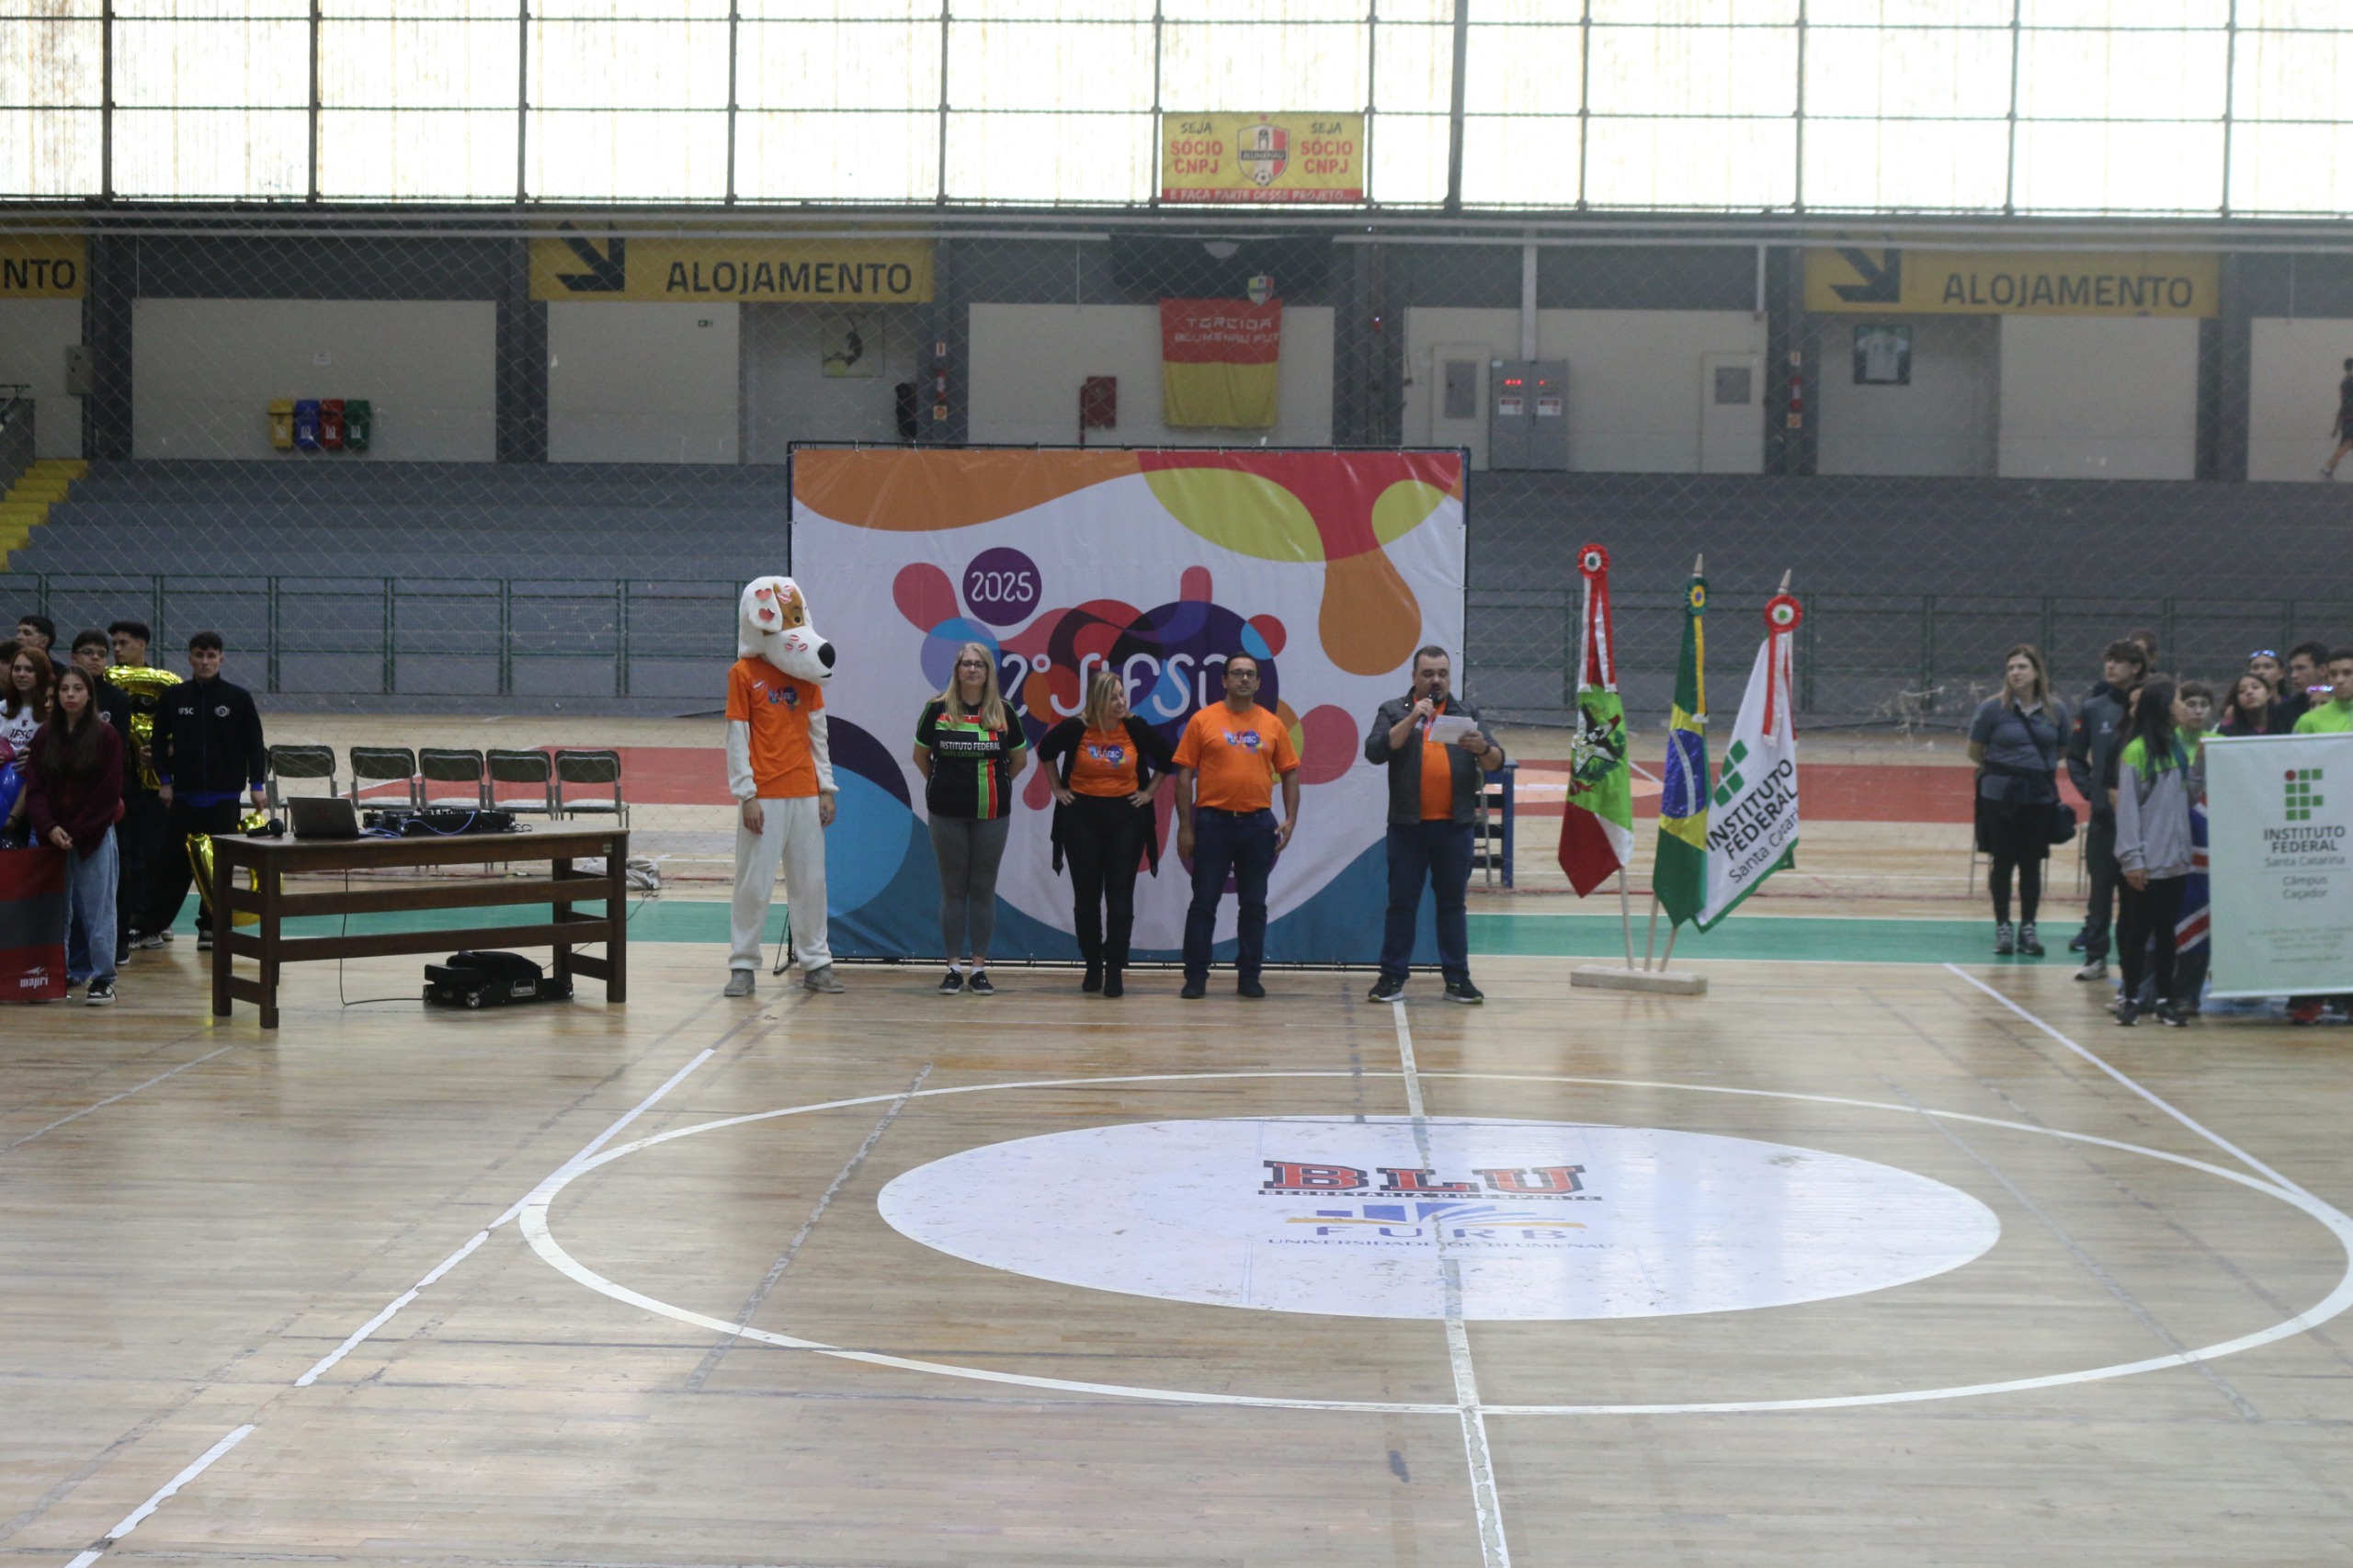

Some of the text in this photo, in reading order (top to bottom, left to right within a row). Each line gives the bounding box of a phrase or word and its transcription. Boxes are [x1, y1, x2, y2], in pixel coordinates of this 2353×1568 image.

[1180, 121, 1212, 134] SEJA
[1311, 121, 1342, 134] SEJA
[1170, 138, 1224, 156] SÓCIO
[1300, 138, 1354, 156] SÓCIO
[1174, 158, 1220, 175] CNPJ
[1304, 158, 1349, 175] CNPJ
[5, 259, 76, 290] NTO
[665, 260, 913, 295] ALOJAMENTO
[1942, 273, 2194, 309] ALOJAMENTO
[972, 571, 1034, 603] 2025
[178, 707, 194, 715] IFSC
[939, 740, 1001, 751] INSTITUTO FEDERAL
[1706, 758, 1794, 853] INSTITUTO
[1724, 784, 1799, 861] FEDERAL
[2263, 825, 2346, 841] INSTITUTO
[2271, 839, 2338, 854] FEDERAL
[1728, 846, 1770, 883] Santa
[2264, 856, 2346, 868] Santa Catarina
[1263, 1160, 1586, 1195] BLU
[1316, 1226, 1567, 1240] FURB
[1268, 1238, 1433, 1247] UNIVERSIDADE
